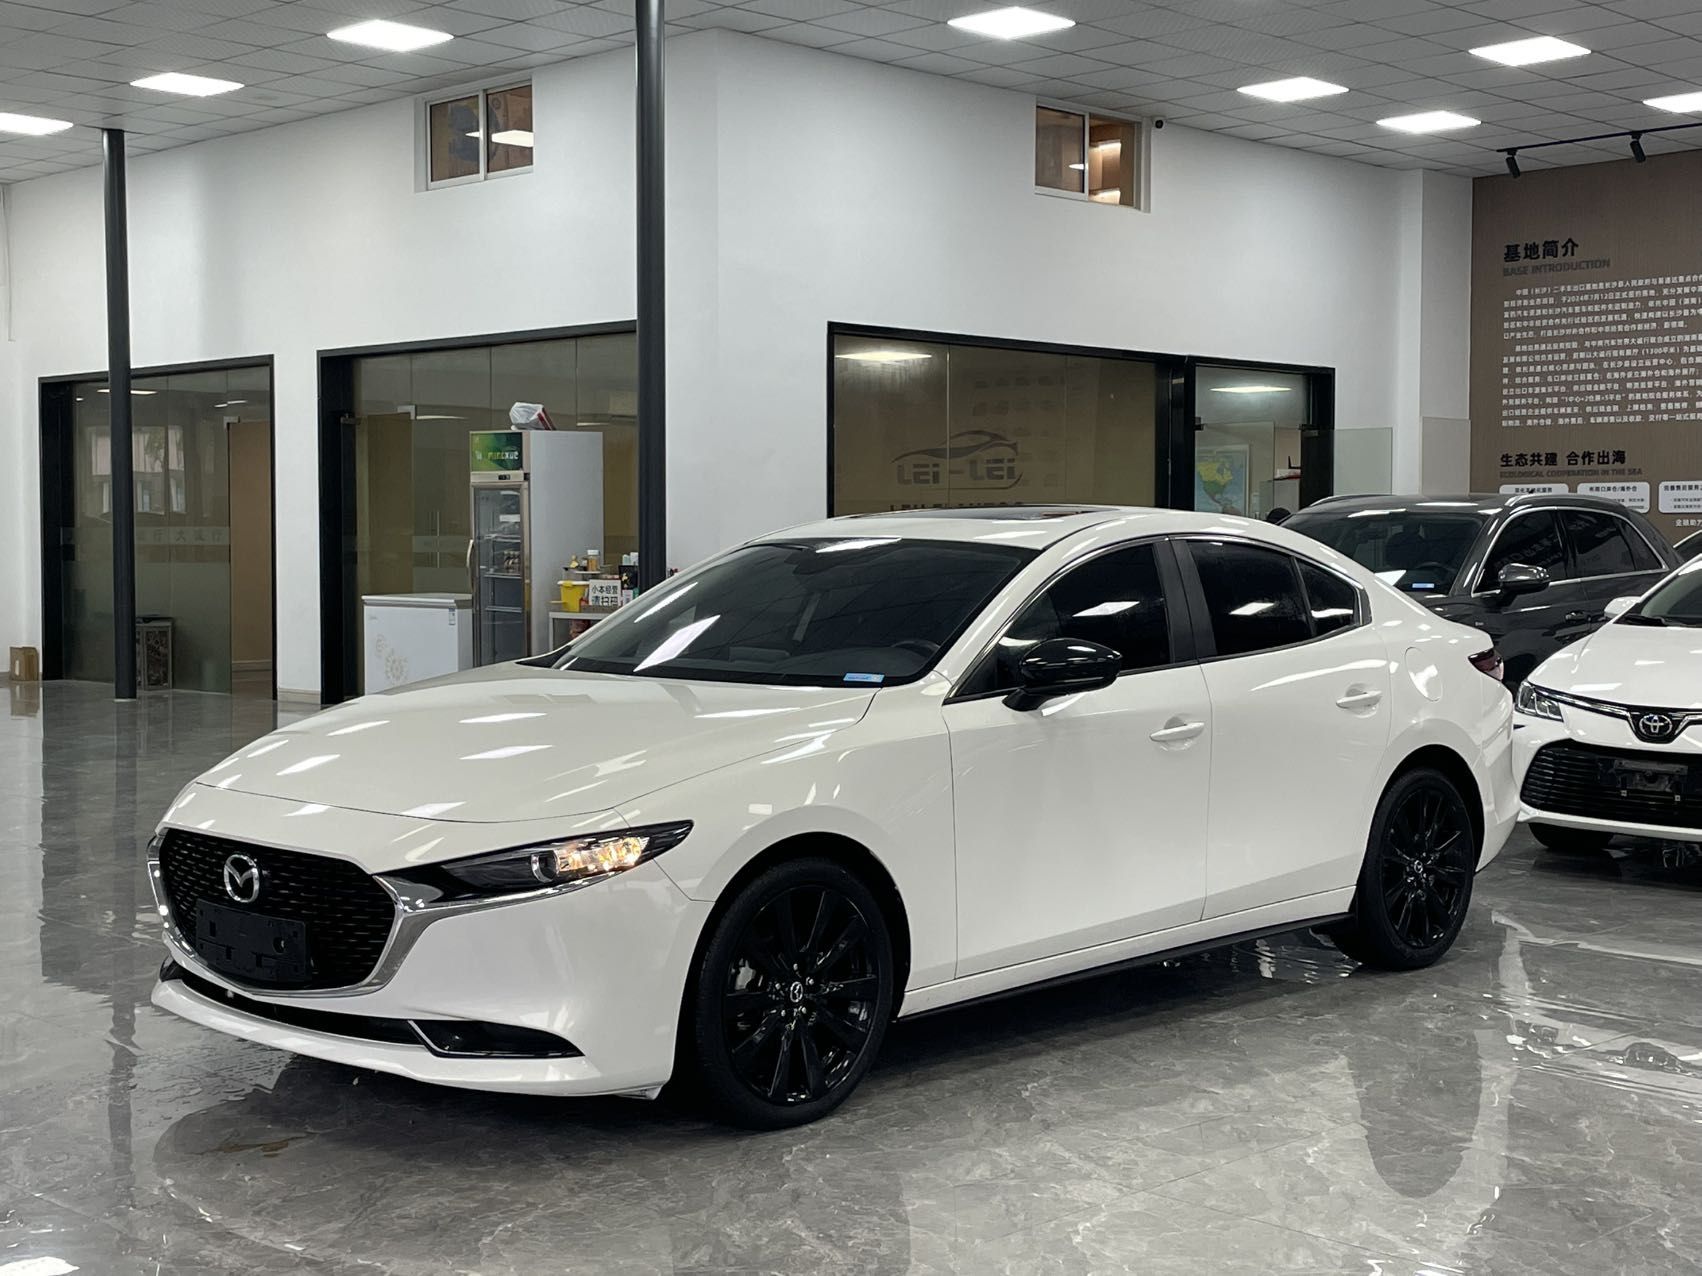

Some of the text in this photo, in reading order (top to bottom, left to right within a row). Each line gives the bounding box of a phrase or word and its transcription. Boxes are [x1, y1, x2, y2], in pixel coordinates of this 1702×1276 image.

[1503, 238, 1579, 262] 基地简介
[1531, 258, 1610, 274] INTRODUCTION
[1500, 449, 1626, 467] 生态共建 合作出海
[591, 584, 618, 594] 小本经营
